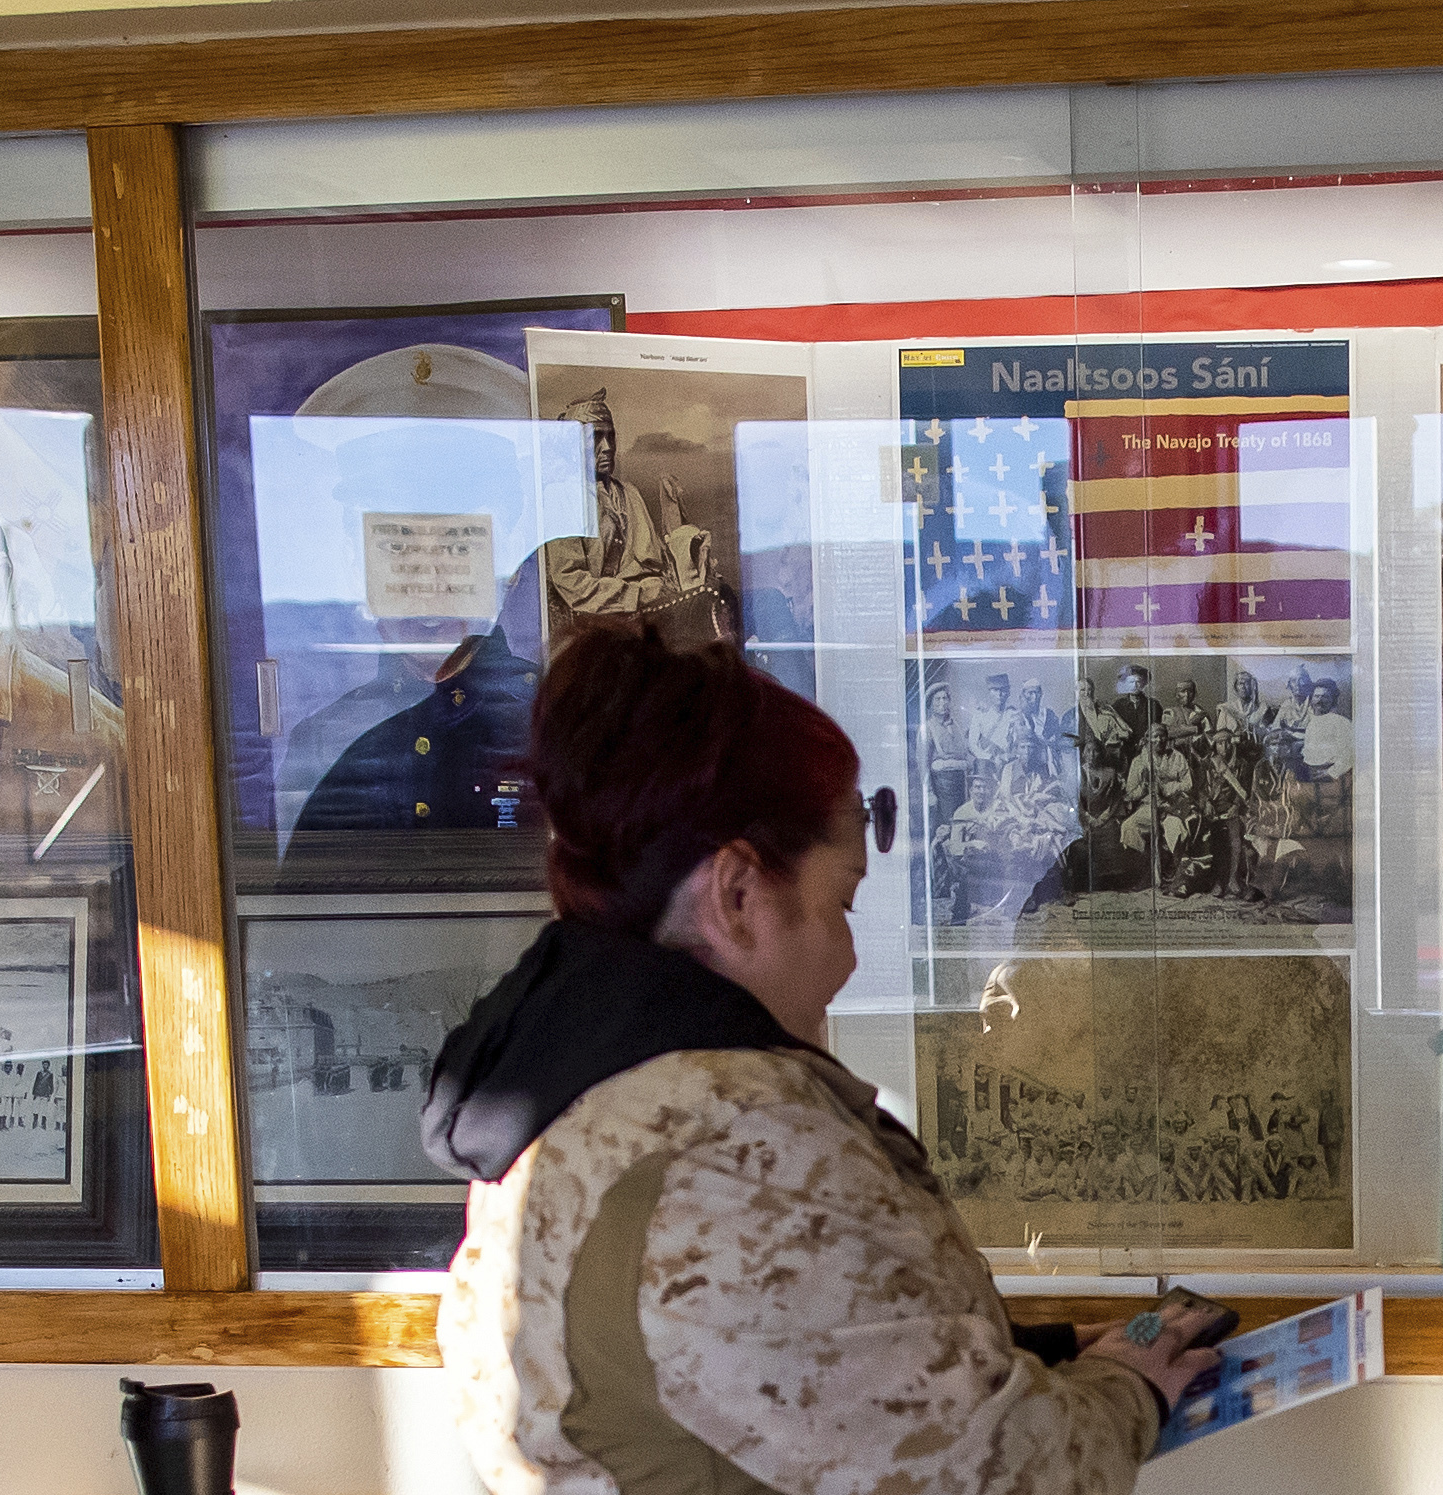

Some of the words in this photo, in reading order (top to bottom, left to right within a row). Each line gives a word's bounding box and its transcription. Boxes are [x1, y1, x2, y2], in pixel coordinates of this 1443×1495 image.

[992, 361, 1178, 394] Naaltsoos
[1192, 356, 1269, 390] Sání
[1122, 434, 1152, 449] The
[1156, 434, 1212, 452] Navajo
[1216, 433, 1265, 451] Treaty
[1271, 432, 1287, 448] of
[1293, 432, 1333, 447] 1868
